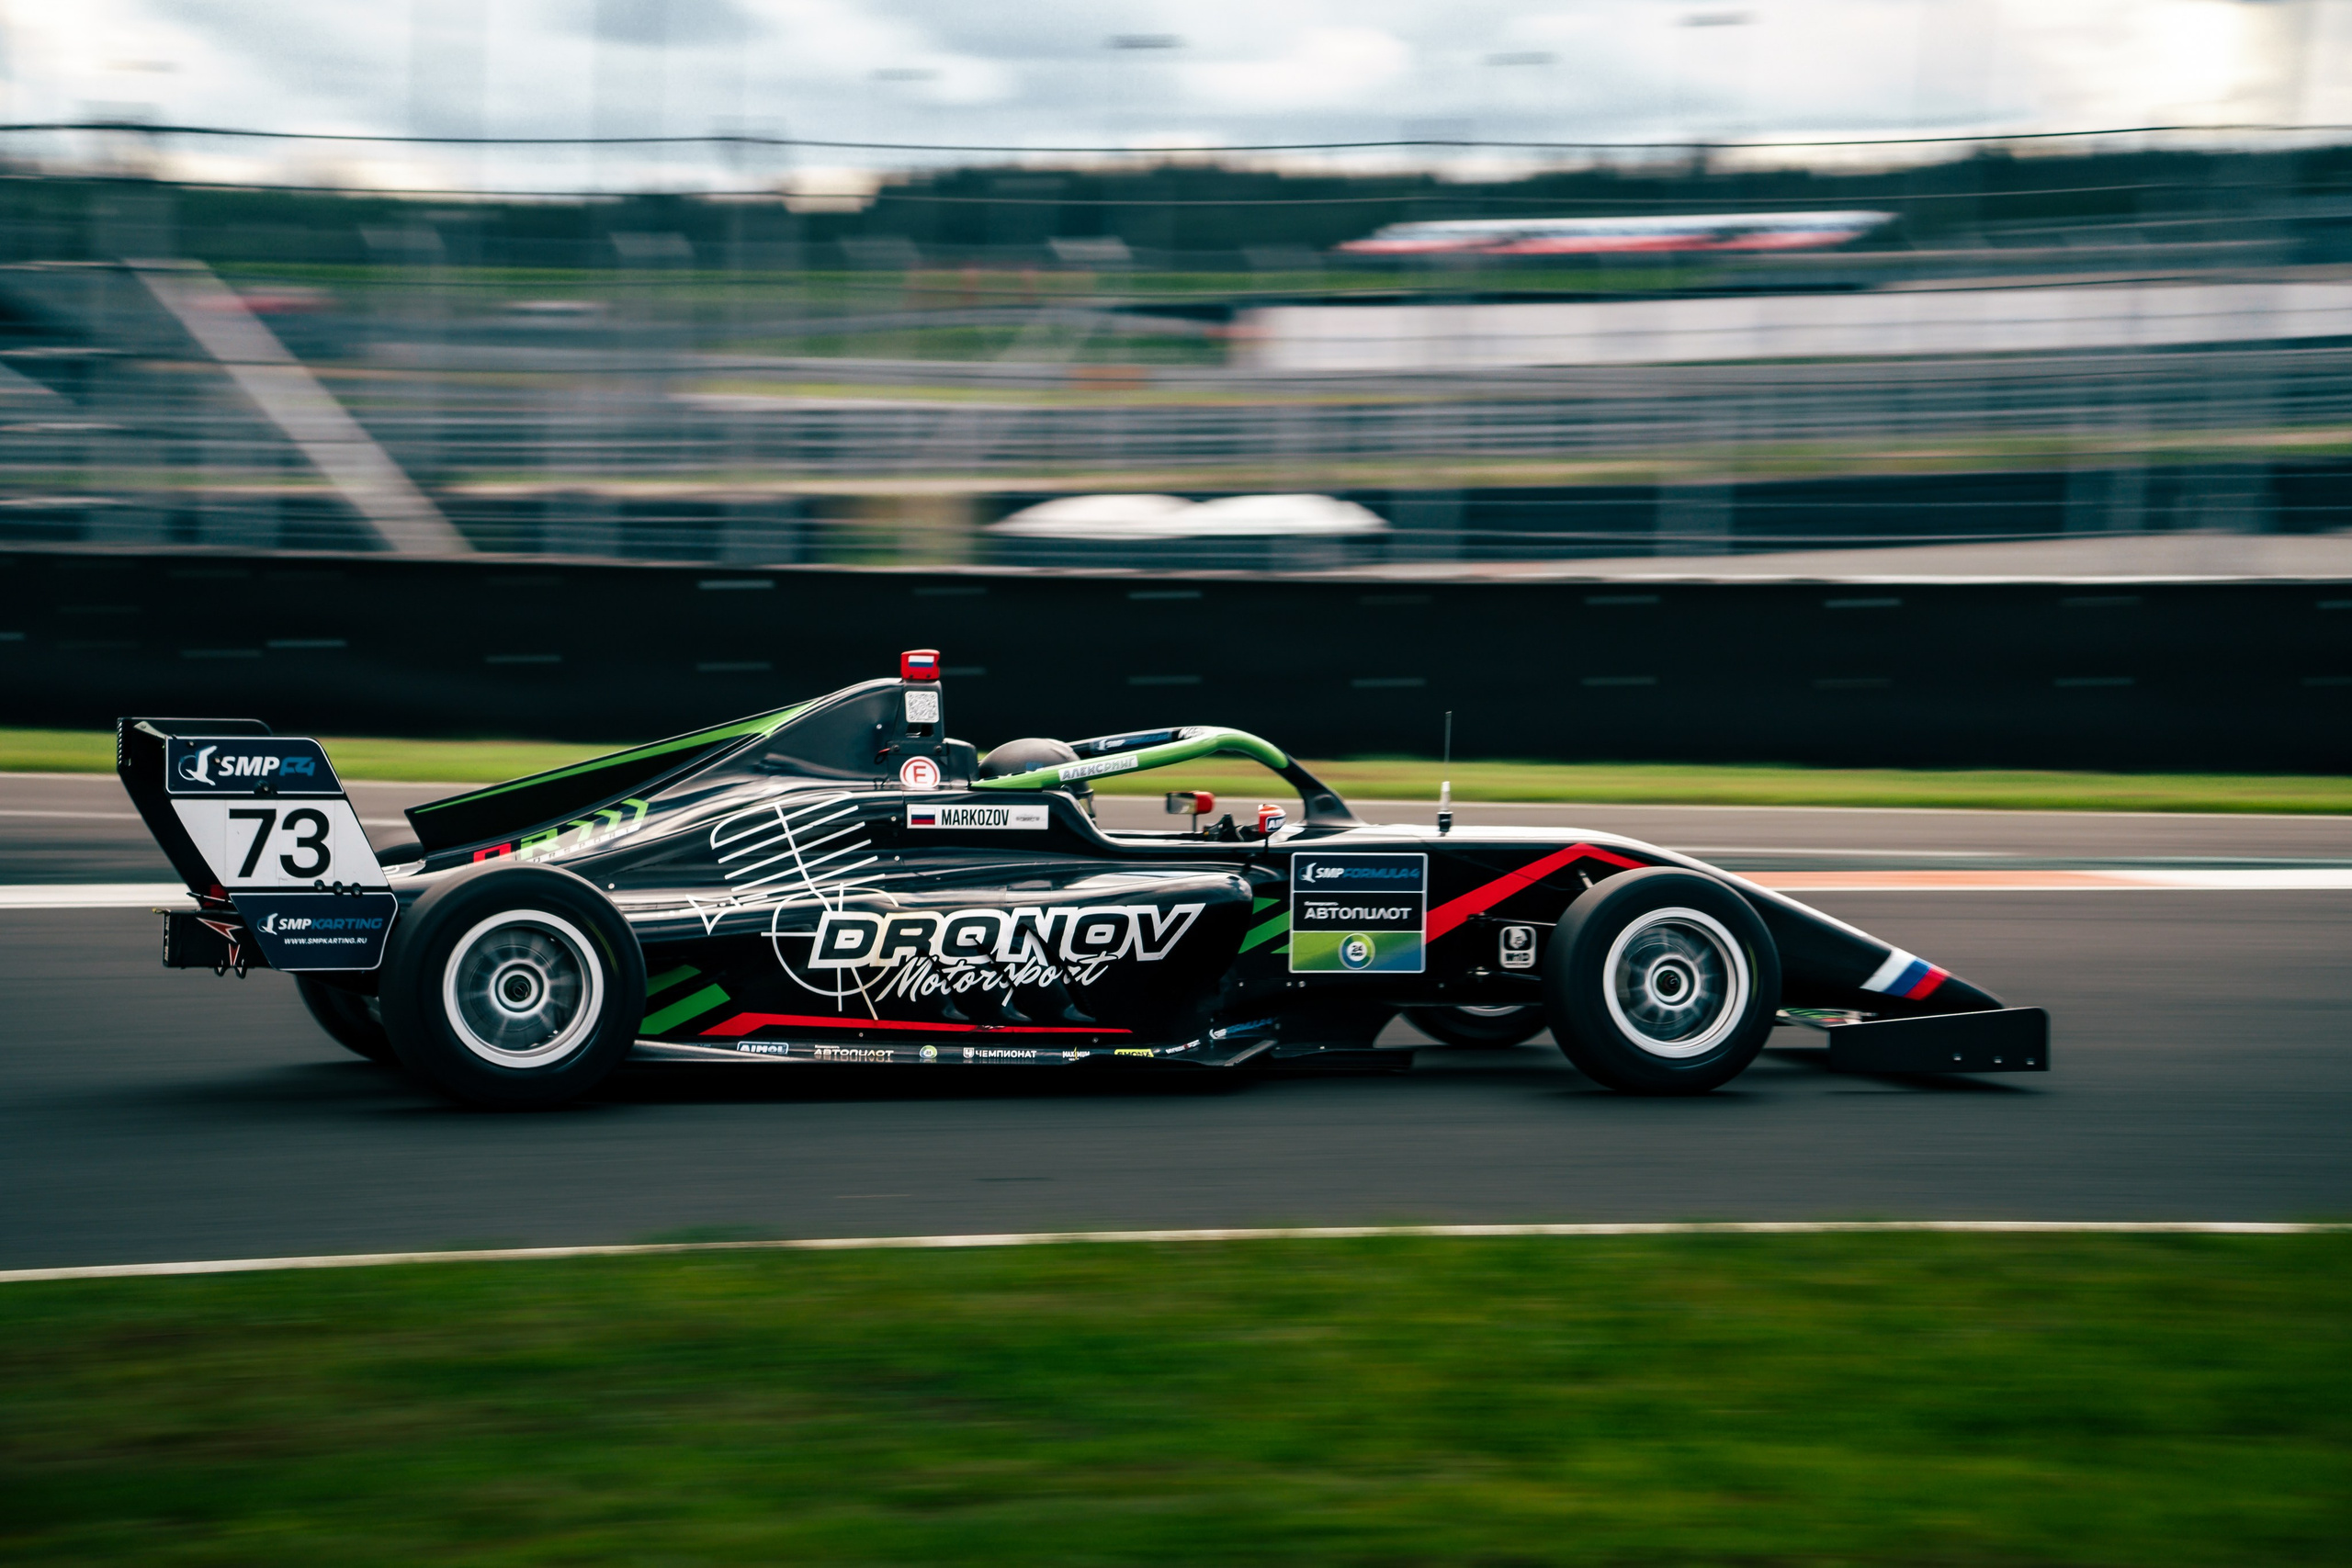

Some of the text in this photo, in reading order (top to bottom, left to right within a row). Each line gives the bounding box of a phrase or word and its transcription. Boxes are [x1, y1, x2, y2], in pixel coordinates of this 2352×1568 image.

[941, 808, 1010, 826] MARKOZOV
[229, 807, 332, 879] 73
[284, 937, 368, 945] WWW.SMPKARTING.RU
[808, 903, 1206, 969] DRONOV
[975, 1050, 1037, 1058] ЧЕМПИОНАТ
